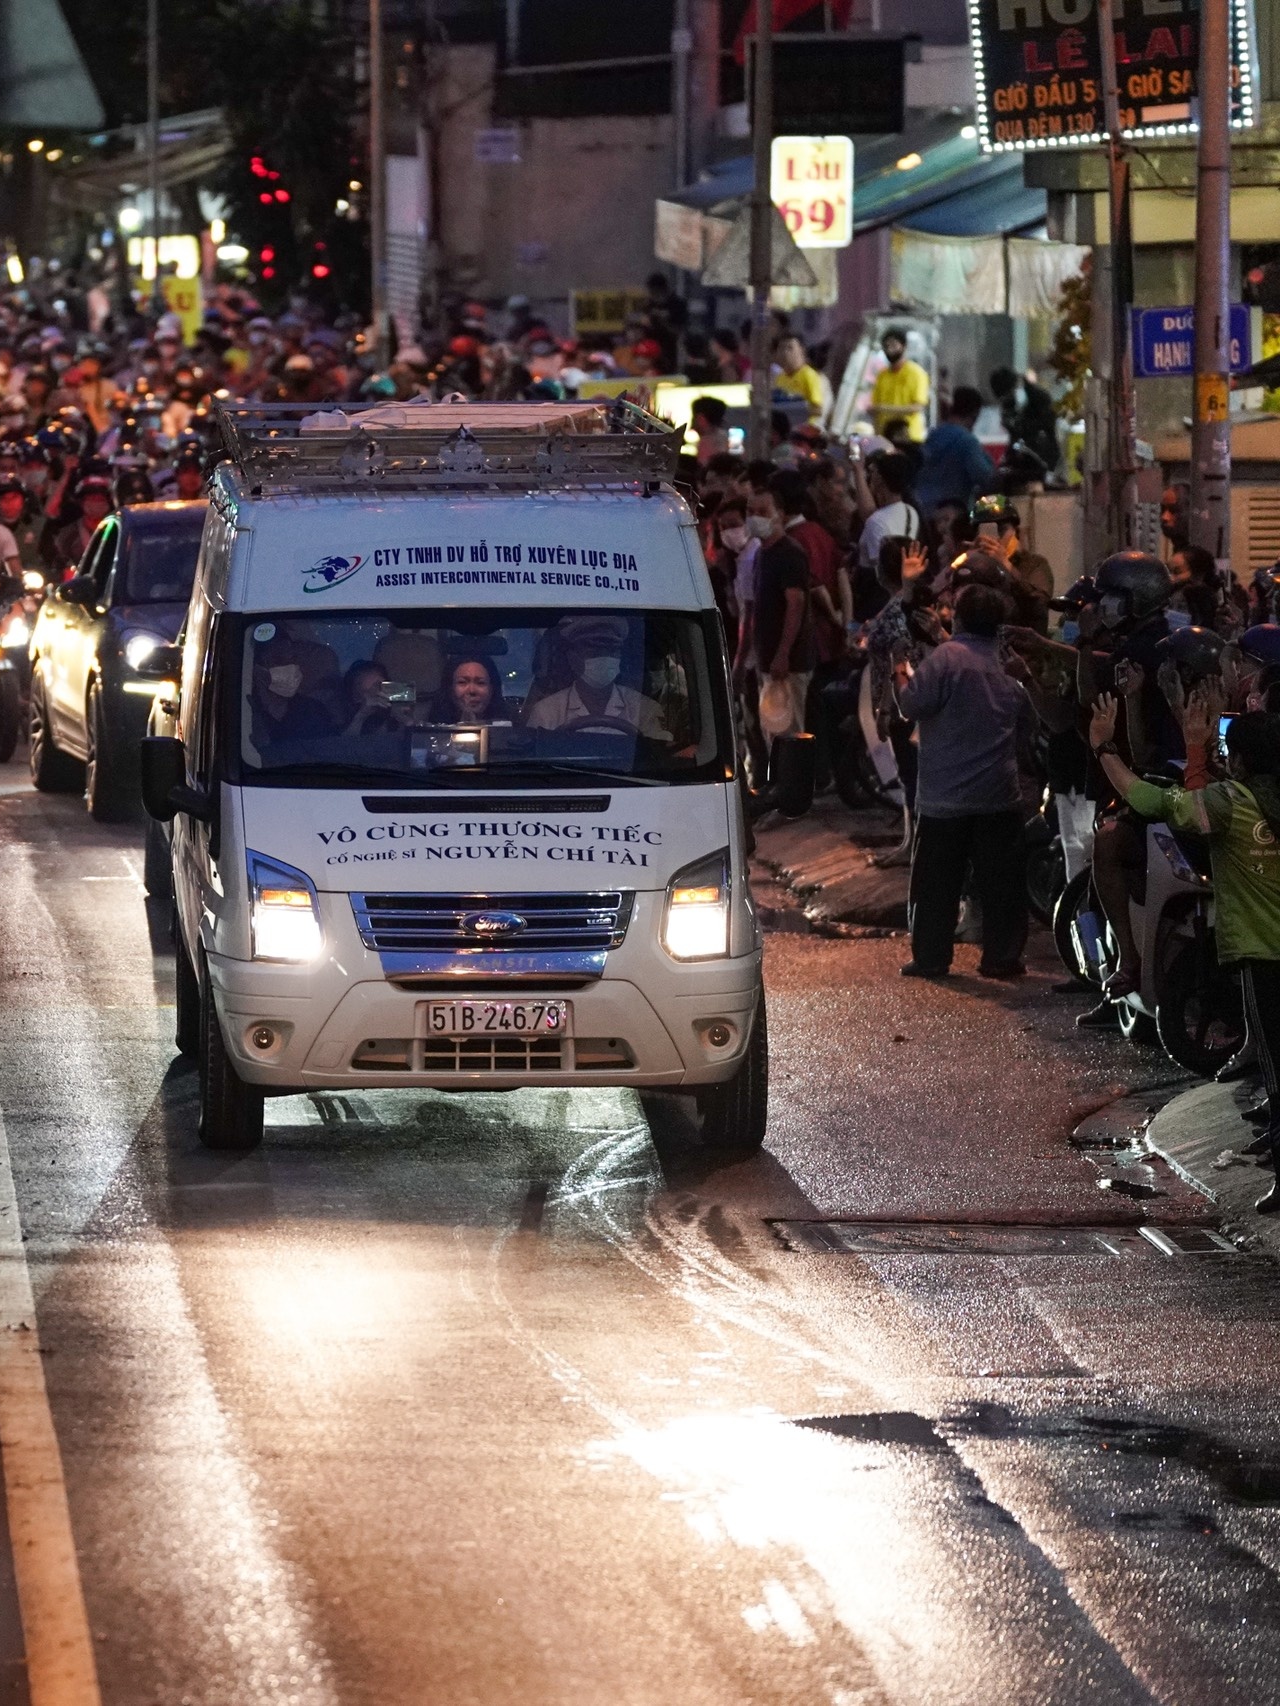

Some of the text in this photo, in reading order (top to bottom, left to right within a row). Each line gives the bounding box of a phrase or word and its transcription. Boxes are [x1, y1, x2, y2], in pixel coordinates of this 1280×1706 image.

[1023, 28, 1088, 72] LÊ
[1127, 67, 1163, 98] GIỜ
[374, 539, 638, 573] CTY TNHH DV HỖ TRỢ XUYÊN LỤC ĐỊA
[376, 573, 417, 587] ASSIST
[421, 571, 537, 585] INTERCONTINENTAL
[541, 572, 591, 587] SERVICE
[317, 821, 663, 846] VÔ CÙNG THƯƠNG TIẾC
[326, 839, 649, 867] CỐ NGHỆ SĨ NGUYỄN CHÍ TÀI
[474, 915, 511, 931] Ford
